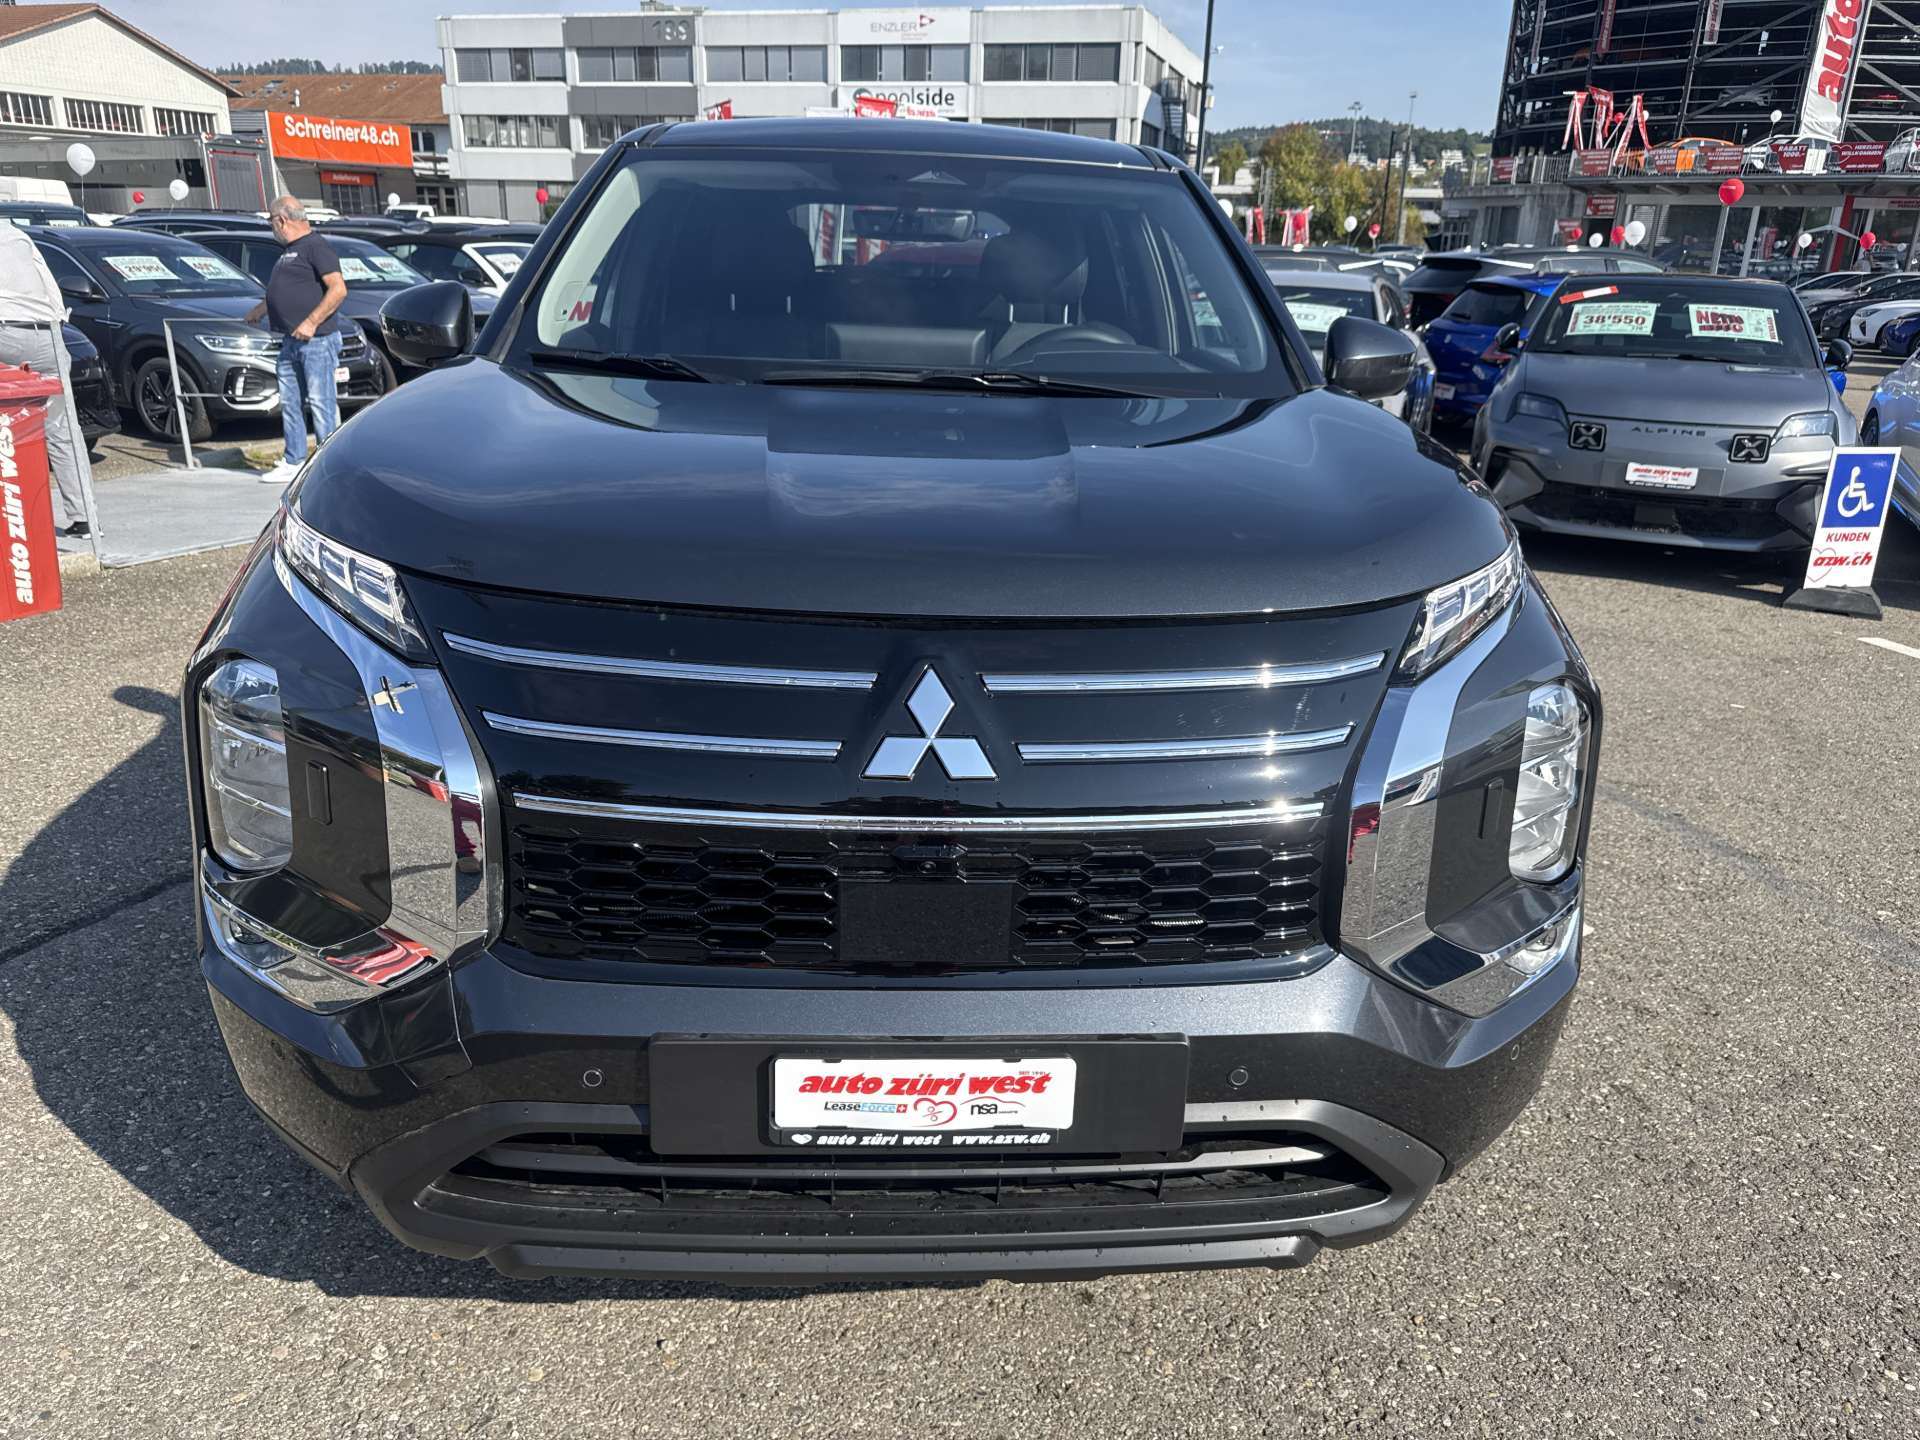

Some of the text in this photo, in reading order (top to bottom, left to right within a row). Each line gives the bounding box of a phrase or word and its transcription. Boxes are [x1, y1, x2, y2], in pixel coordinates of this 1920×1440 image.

[870, 22, 917, 33] ENZLER
[1817, 0, 1864, 103] auto
[284, 115, 399, 147] Schreiner48.ch
[1583, 314, 1647, 326] 38'550
[1631, 426, 1707, 437] ALPINE
[2, 481, 27, 542] züri
[1826, 532, 1871, 542] KUNDEN
[1813, 552, 1873, 567] azw.ch
[10, 542, 34, 605] auto
[798, 1072, 1053, 1096] auto züri west
[824, 1101, 897, 1113] LeaseForce
[970, 1103, 998, 1115] nsa
[816, 1132, 1051, 1145] auto züri west www.azw.ch
